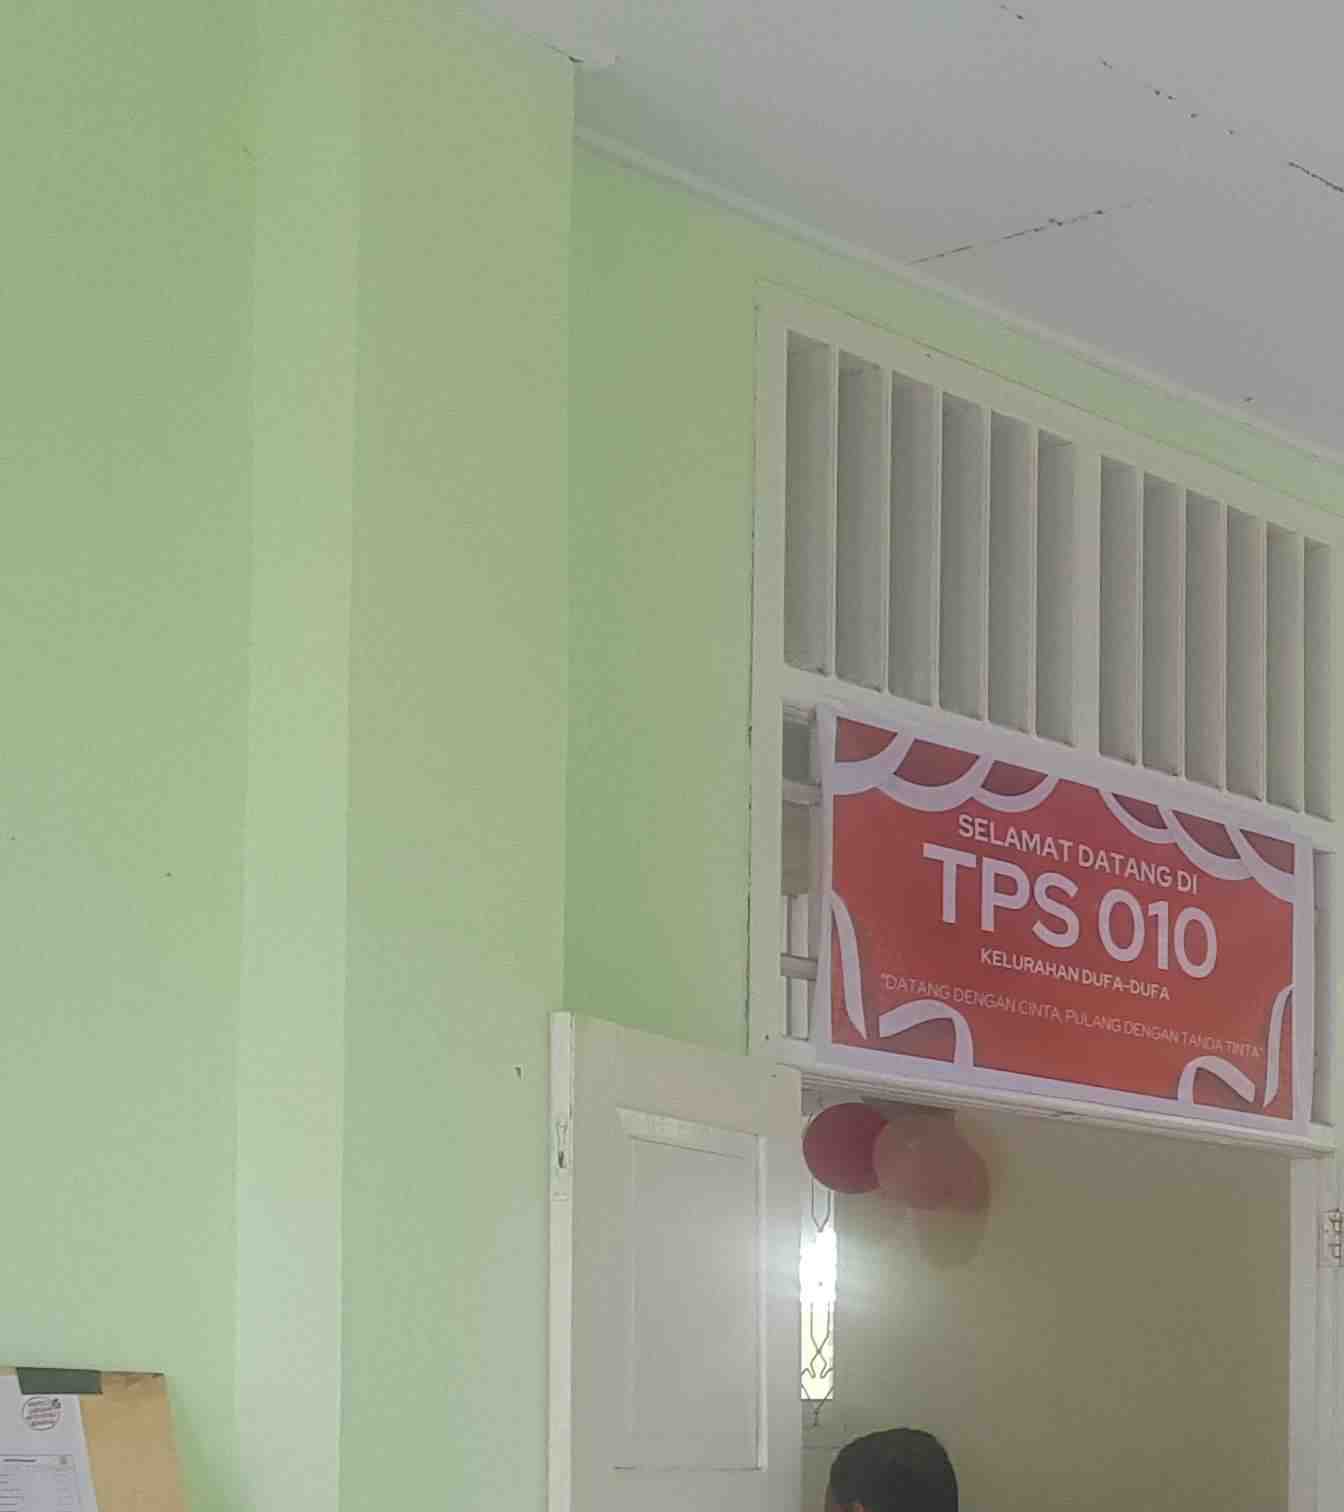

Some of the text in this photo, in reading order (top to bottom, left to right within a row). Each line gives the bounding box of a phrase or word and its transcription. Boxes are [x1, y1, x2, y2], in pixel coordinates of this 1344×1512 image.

[958, 814, 1199, 895] SELAMAT DATANG DI
[922, 842, 1218, 979] TPS 010
[980, 947, 1171, 1001] KELURAHAN DUFA-DUFA
[952, 987, 1016, 1013] DENGAN
[1064, 1008, 1121, 1034] PULANG
[1122, 1020, 1179, 1043] DENGAN
[1181, 1031, 1224, 1052] TANDA
